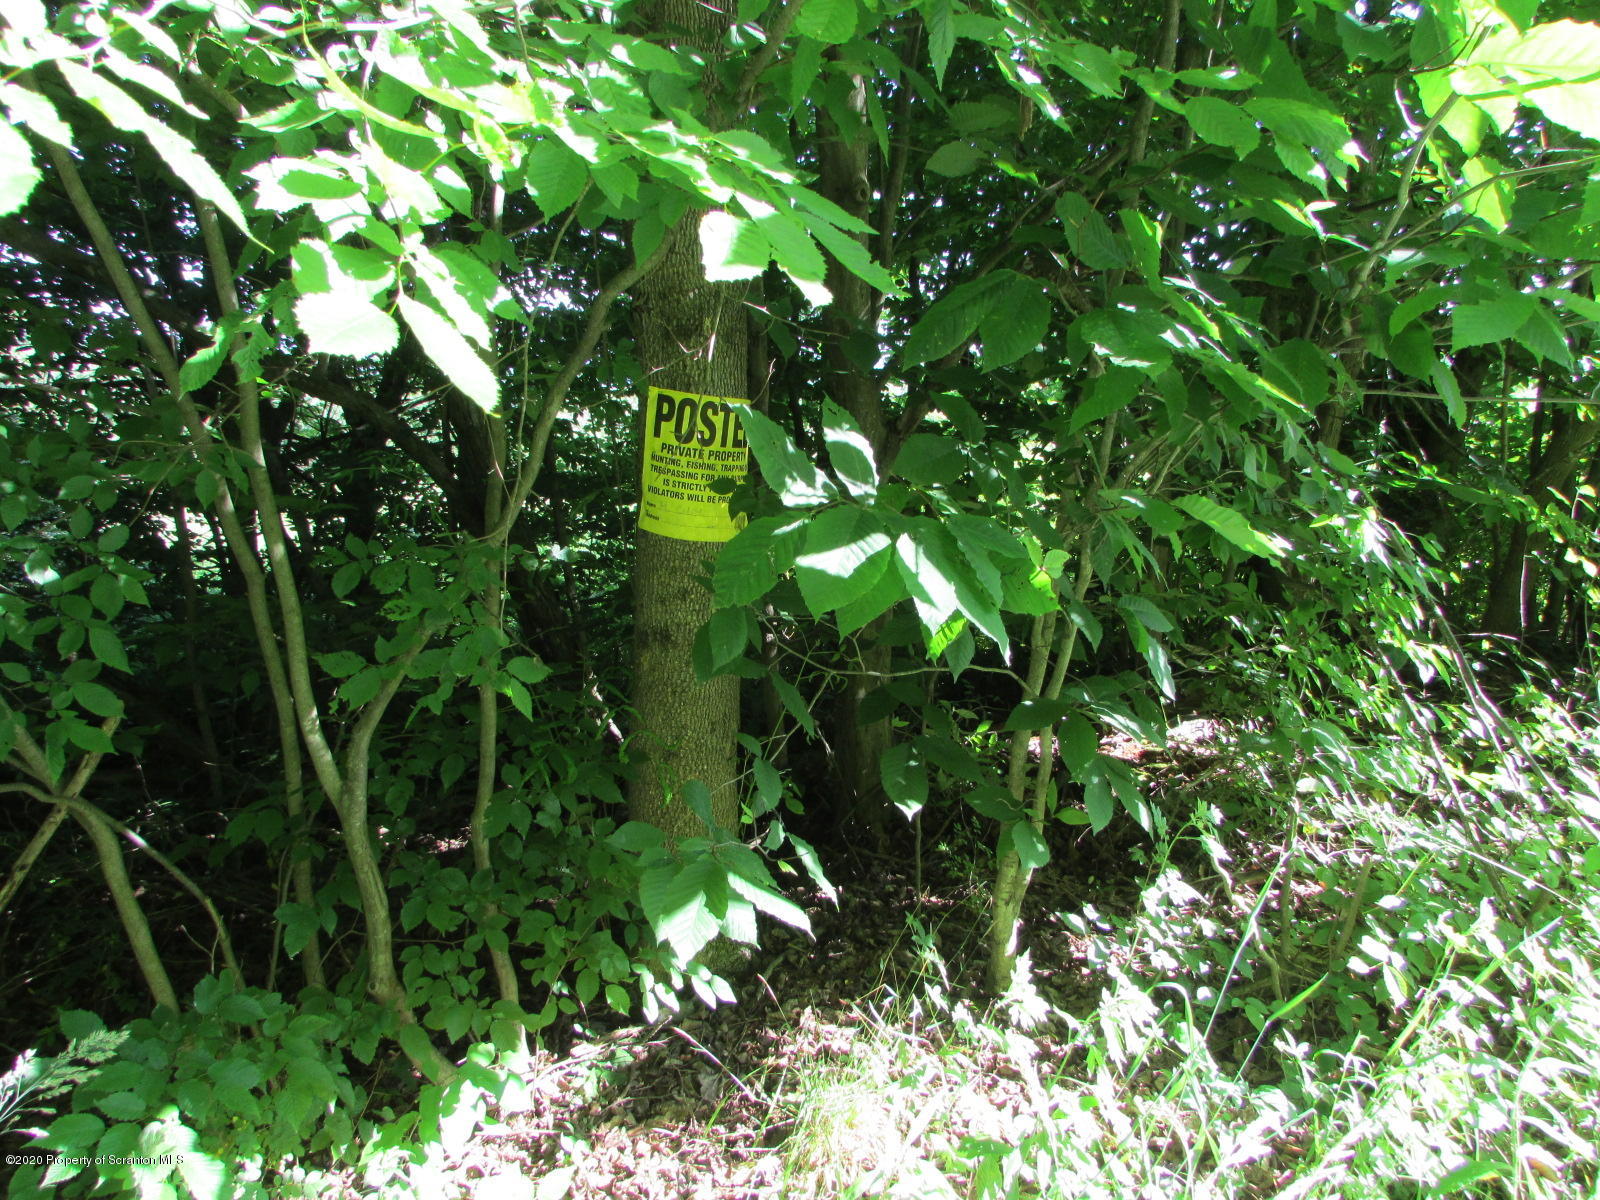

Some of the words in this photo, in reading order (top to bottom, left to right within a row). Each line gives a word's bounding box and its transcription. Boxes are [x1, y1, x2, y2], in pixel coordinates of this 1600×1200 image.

[660, 442, 704, 460] PRIVATE
[650, 463, 699, 481] TRESPASSING
[700, 473, 715, 482] FOR
[662, 478, 670, 487] IS
[647, 484, 685, 500] VIOLATORS
[687, 494, 705, 503] WILL
[707, 495, 717, 504] BE
